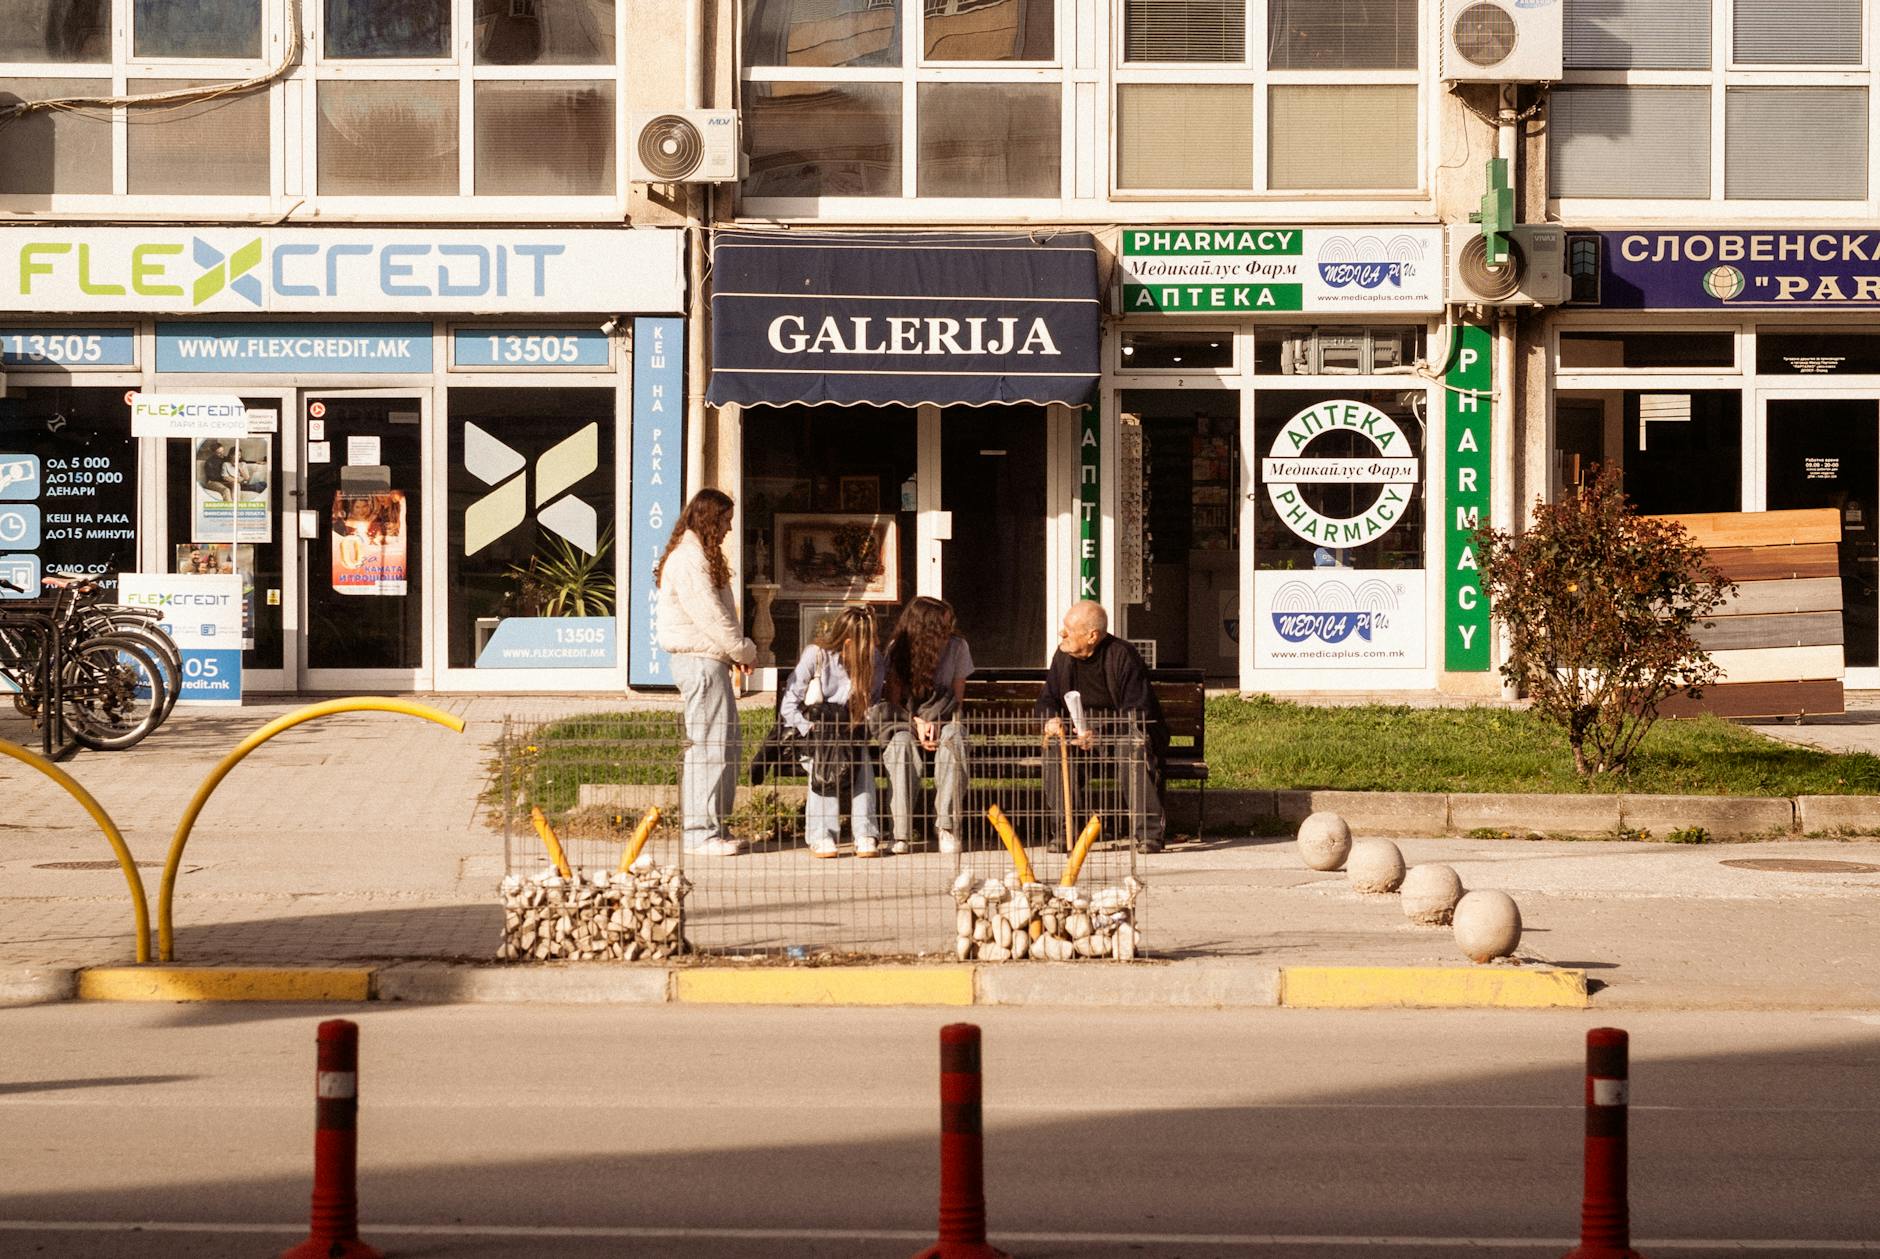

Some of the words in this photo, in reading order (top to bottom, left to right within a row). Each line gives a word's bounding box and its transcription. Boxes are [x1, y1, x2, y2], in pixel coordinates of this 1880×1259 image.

[1134, 231, 1294, 251] PHARMACY
[20, 236, 566, 307] FLEXCREDIT
[1245, 260, 1297, 279] Фарм
[1324, 264, 1381, 286] MEDICA
[1135, 287, 1277, 307] АПТЕКА
[1317, 294, 1430, 303] www.medicaplus.com.mk
[767, 314, 1062, 355] GALERIJA
[12, 334, 102, 361] 13505
[178, 338, 411, 358] WWW.FLEXCREDIT.MK
[488, 335, 579, 363] 13505
[136, 403, 246, 417] FLEXCREDIT
[1286, 404, 1396, 450] АПТЕКА
[46, 458, 68, 469] ОД
[71, 457, 80, 468] 5
[83, 457, 110, 469] 000
[1367, 462, 1412, 479] Фарм
[96, 472, 123, 484] 000
[46, 486, 96, 497] ДЕНАРИ
[1456, 348, 1479, 650] PHARMACY
[46, 513, 72, 523] КЕШ
[75, 513, 93, 523] НА
[97, 513, 129, 523] РАКА
[1080, 428, 1097, 596] АПТЕК
[1276, 488, 1404, 543] PHARMACY
[86, 529, 135, 539] МИНУТИ
[46, 563, 84, 573] САМО
[87, 564, 107, 574] СО
[128, 593, 230, 606] FLEXCREDIT
[1279, 613, 1348, 637] MEDICA
[556, 628, 605, 643] 13505
[502, 648, 607, 658] WWW.FLEXCREDIT.MK
[1271, 649, 1406, 659] www.medicaplus.com.mk
